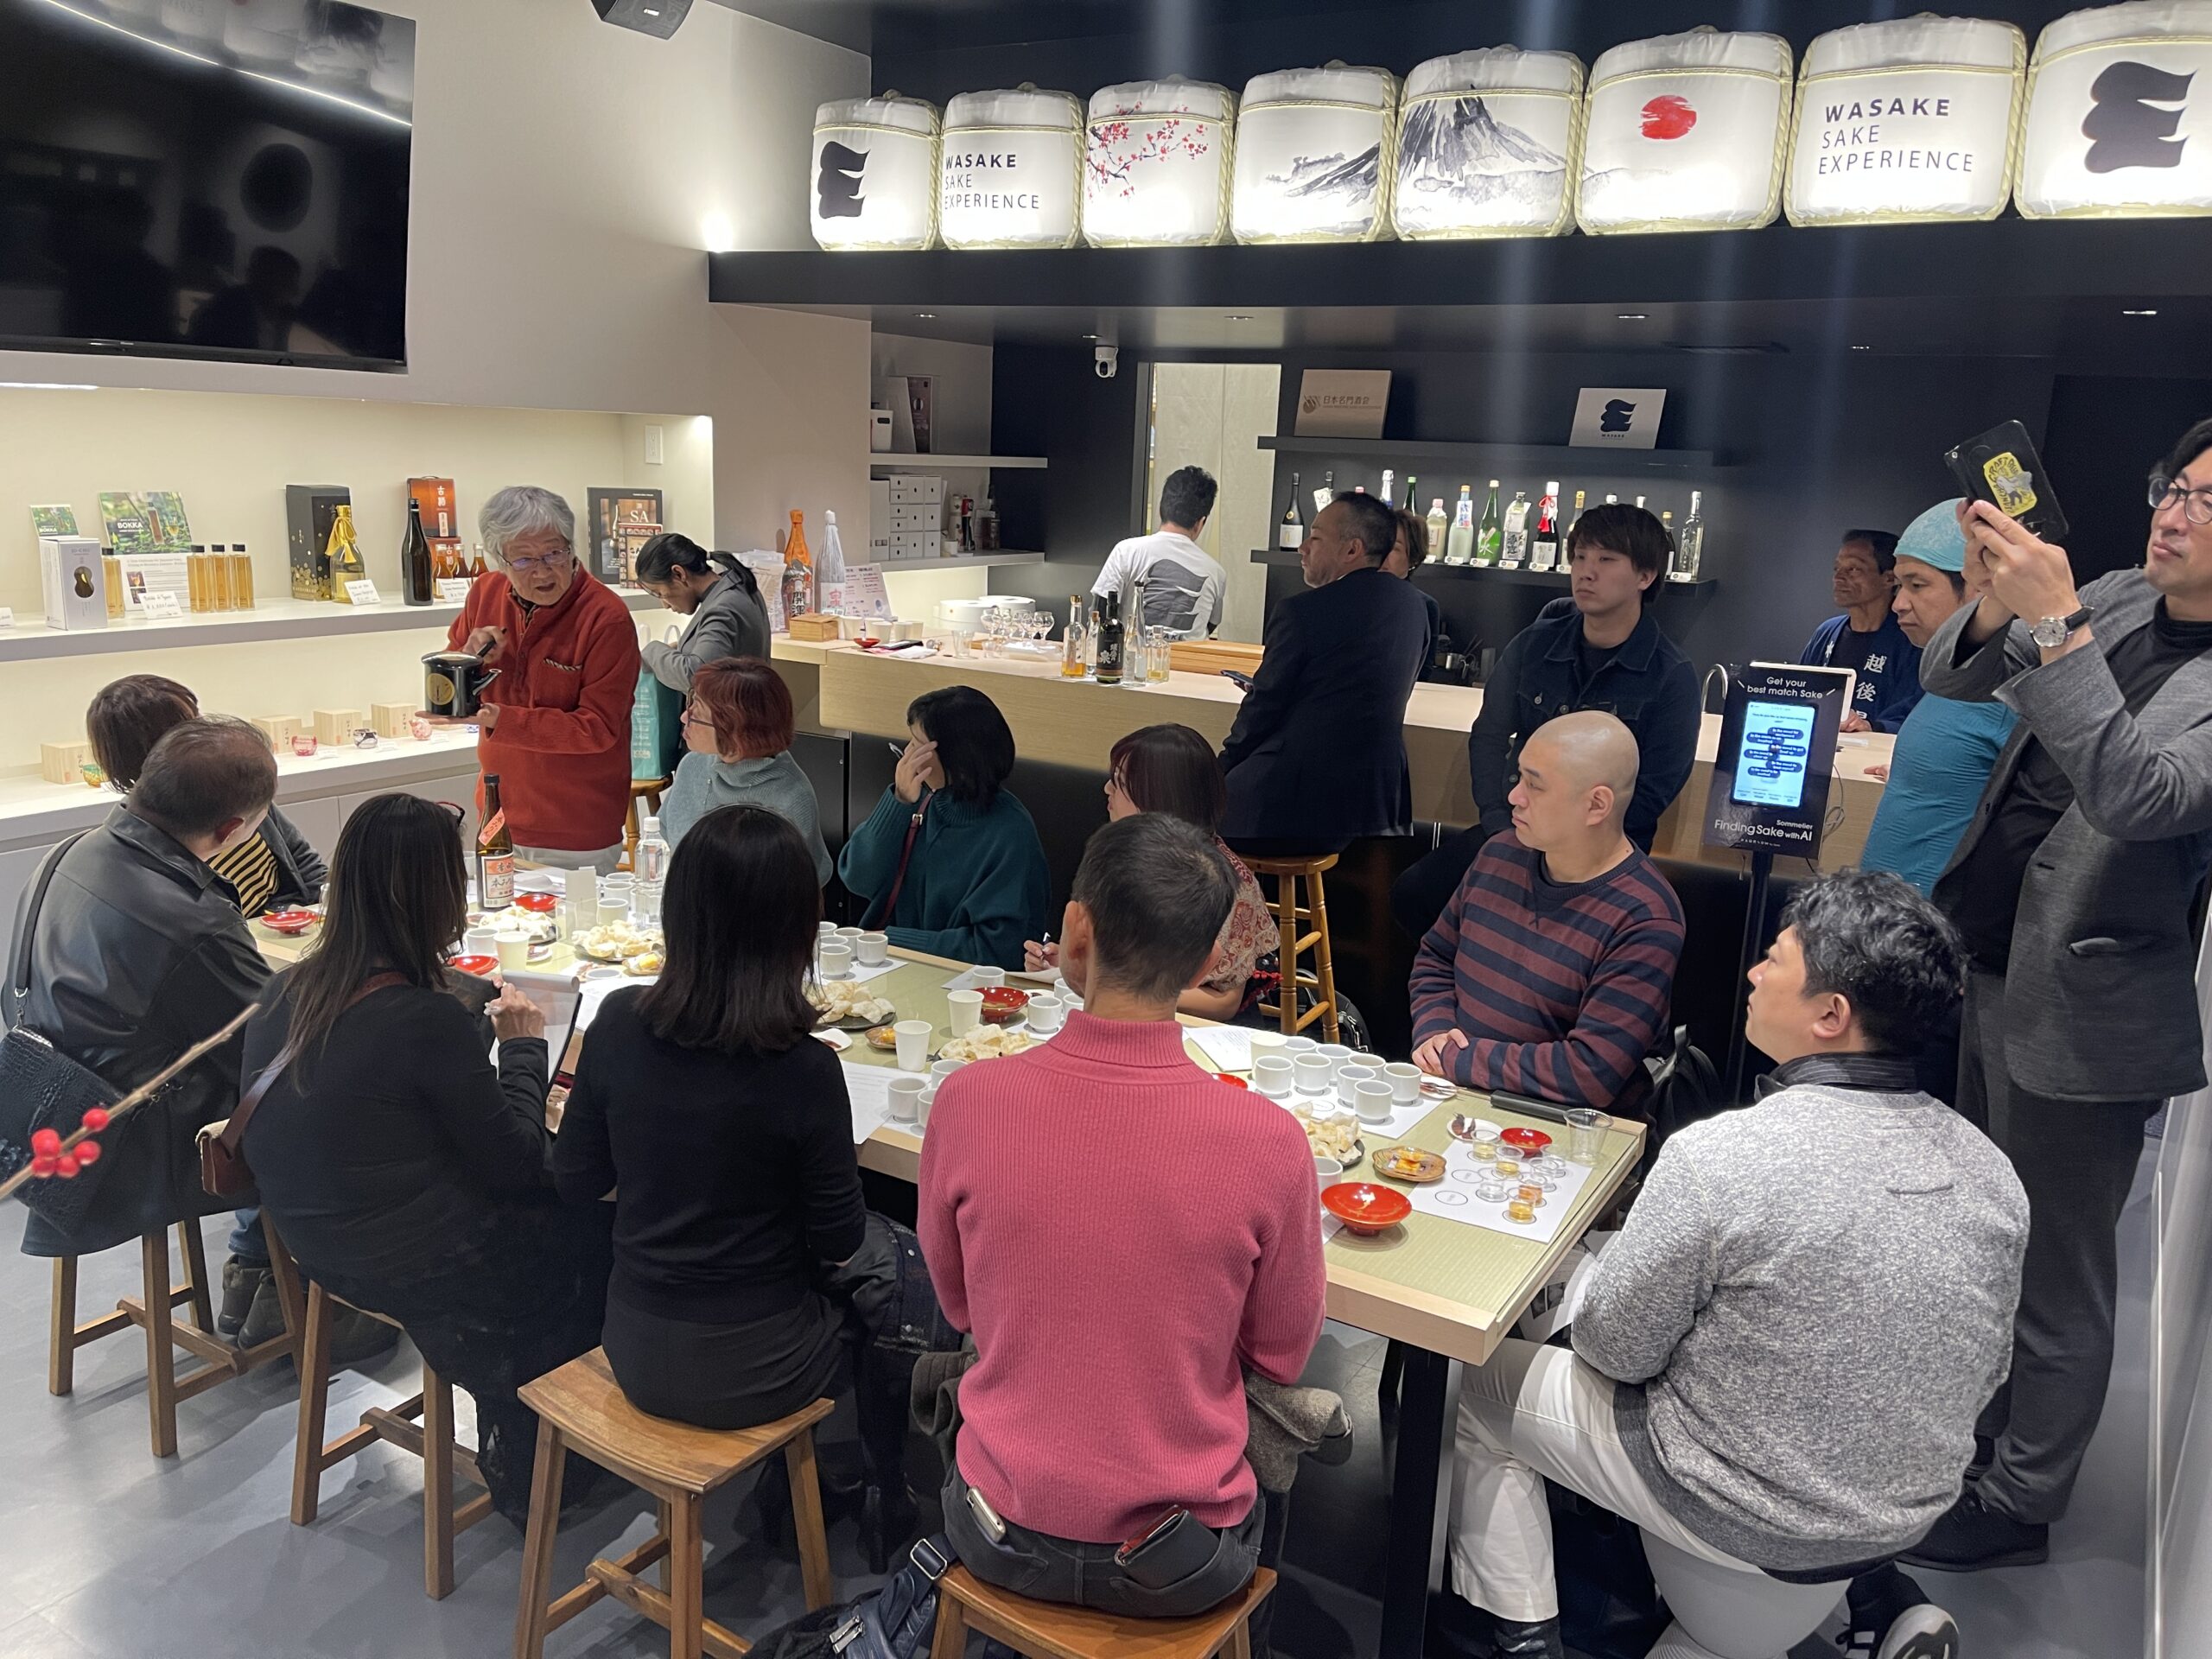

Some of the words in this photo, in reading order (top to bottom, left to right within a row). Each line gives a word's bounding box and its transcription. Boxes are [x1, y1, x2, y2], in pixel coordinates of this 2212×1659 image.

[1825, 98, 1950, 124] WASAKE
[1821, 124, 1880, 149] SAKE
[945, 154, 1016, 169] WASAKE
[1818, 150, 1974, 175] EXPERIENCE
[944, 174, 972, 190] SAKE
[944, 193, 1039, 210] EXPERIENCE
[1766, 677, 1783, 685] Get
[1785, 679, 1807, 688] your
[1768, 688, 1798, 696] match
[1800, 690, 1823, 699] Sake
[1714, 819, 1756, 836] Finding
[1756, 824, 1784, 837] Sake
[1784, 831, 1800, 840] with
[1800, 830, 1813, 842] AI
[1776, 819, 1814, 830] Sommelier
